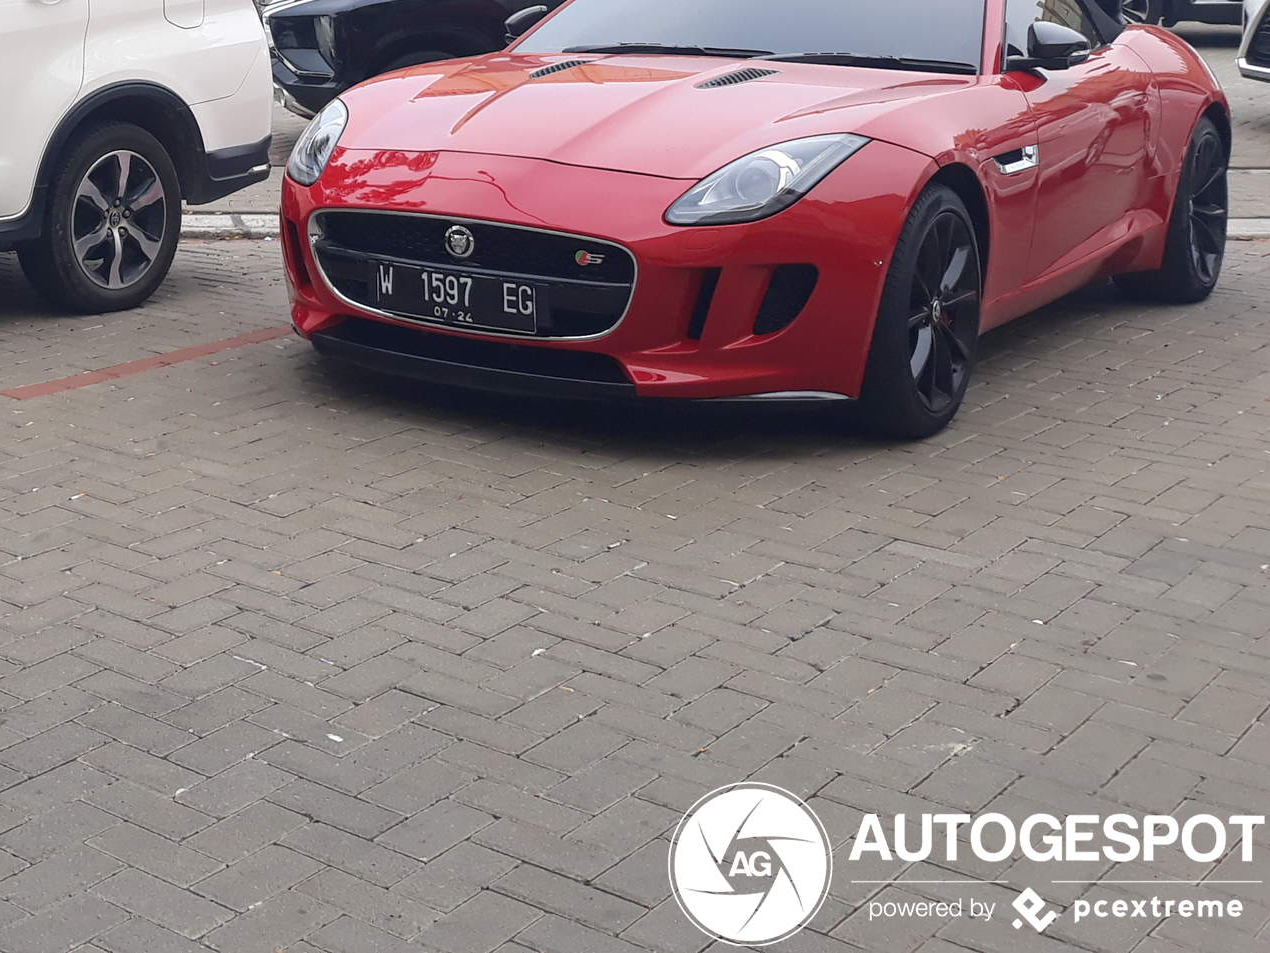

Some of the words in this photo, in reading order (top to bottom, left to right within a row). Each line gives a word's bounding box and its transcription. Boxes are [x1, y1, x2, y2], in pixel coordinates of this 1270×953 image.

[380, 265, 393, 295] W
[421, 272, 473, 307] 1597
[503, 282, 533, 315] EG
